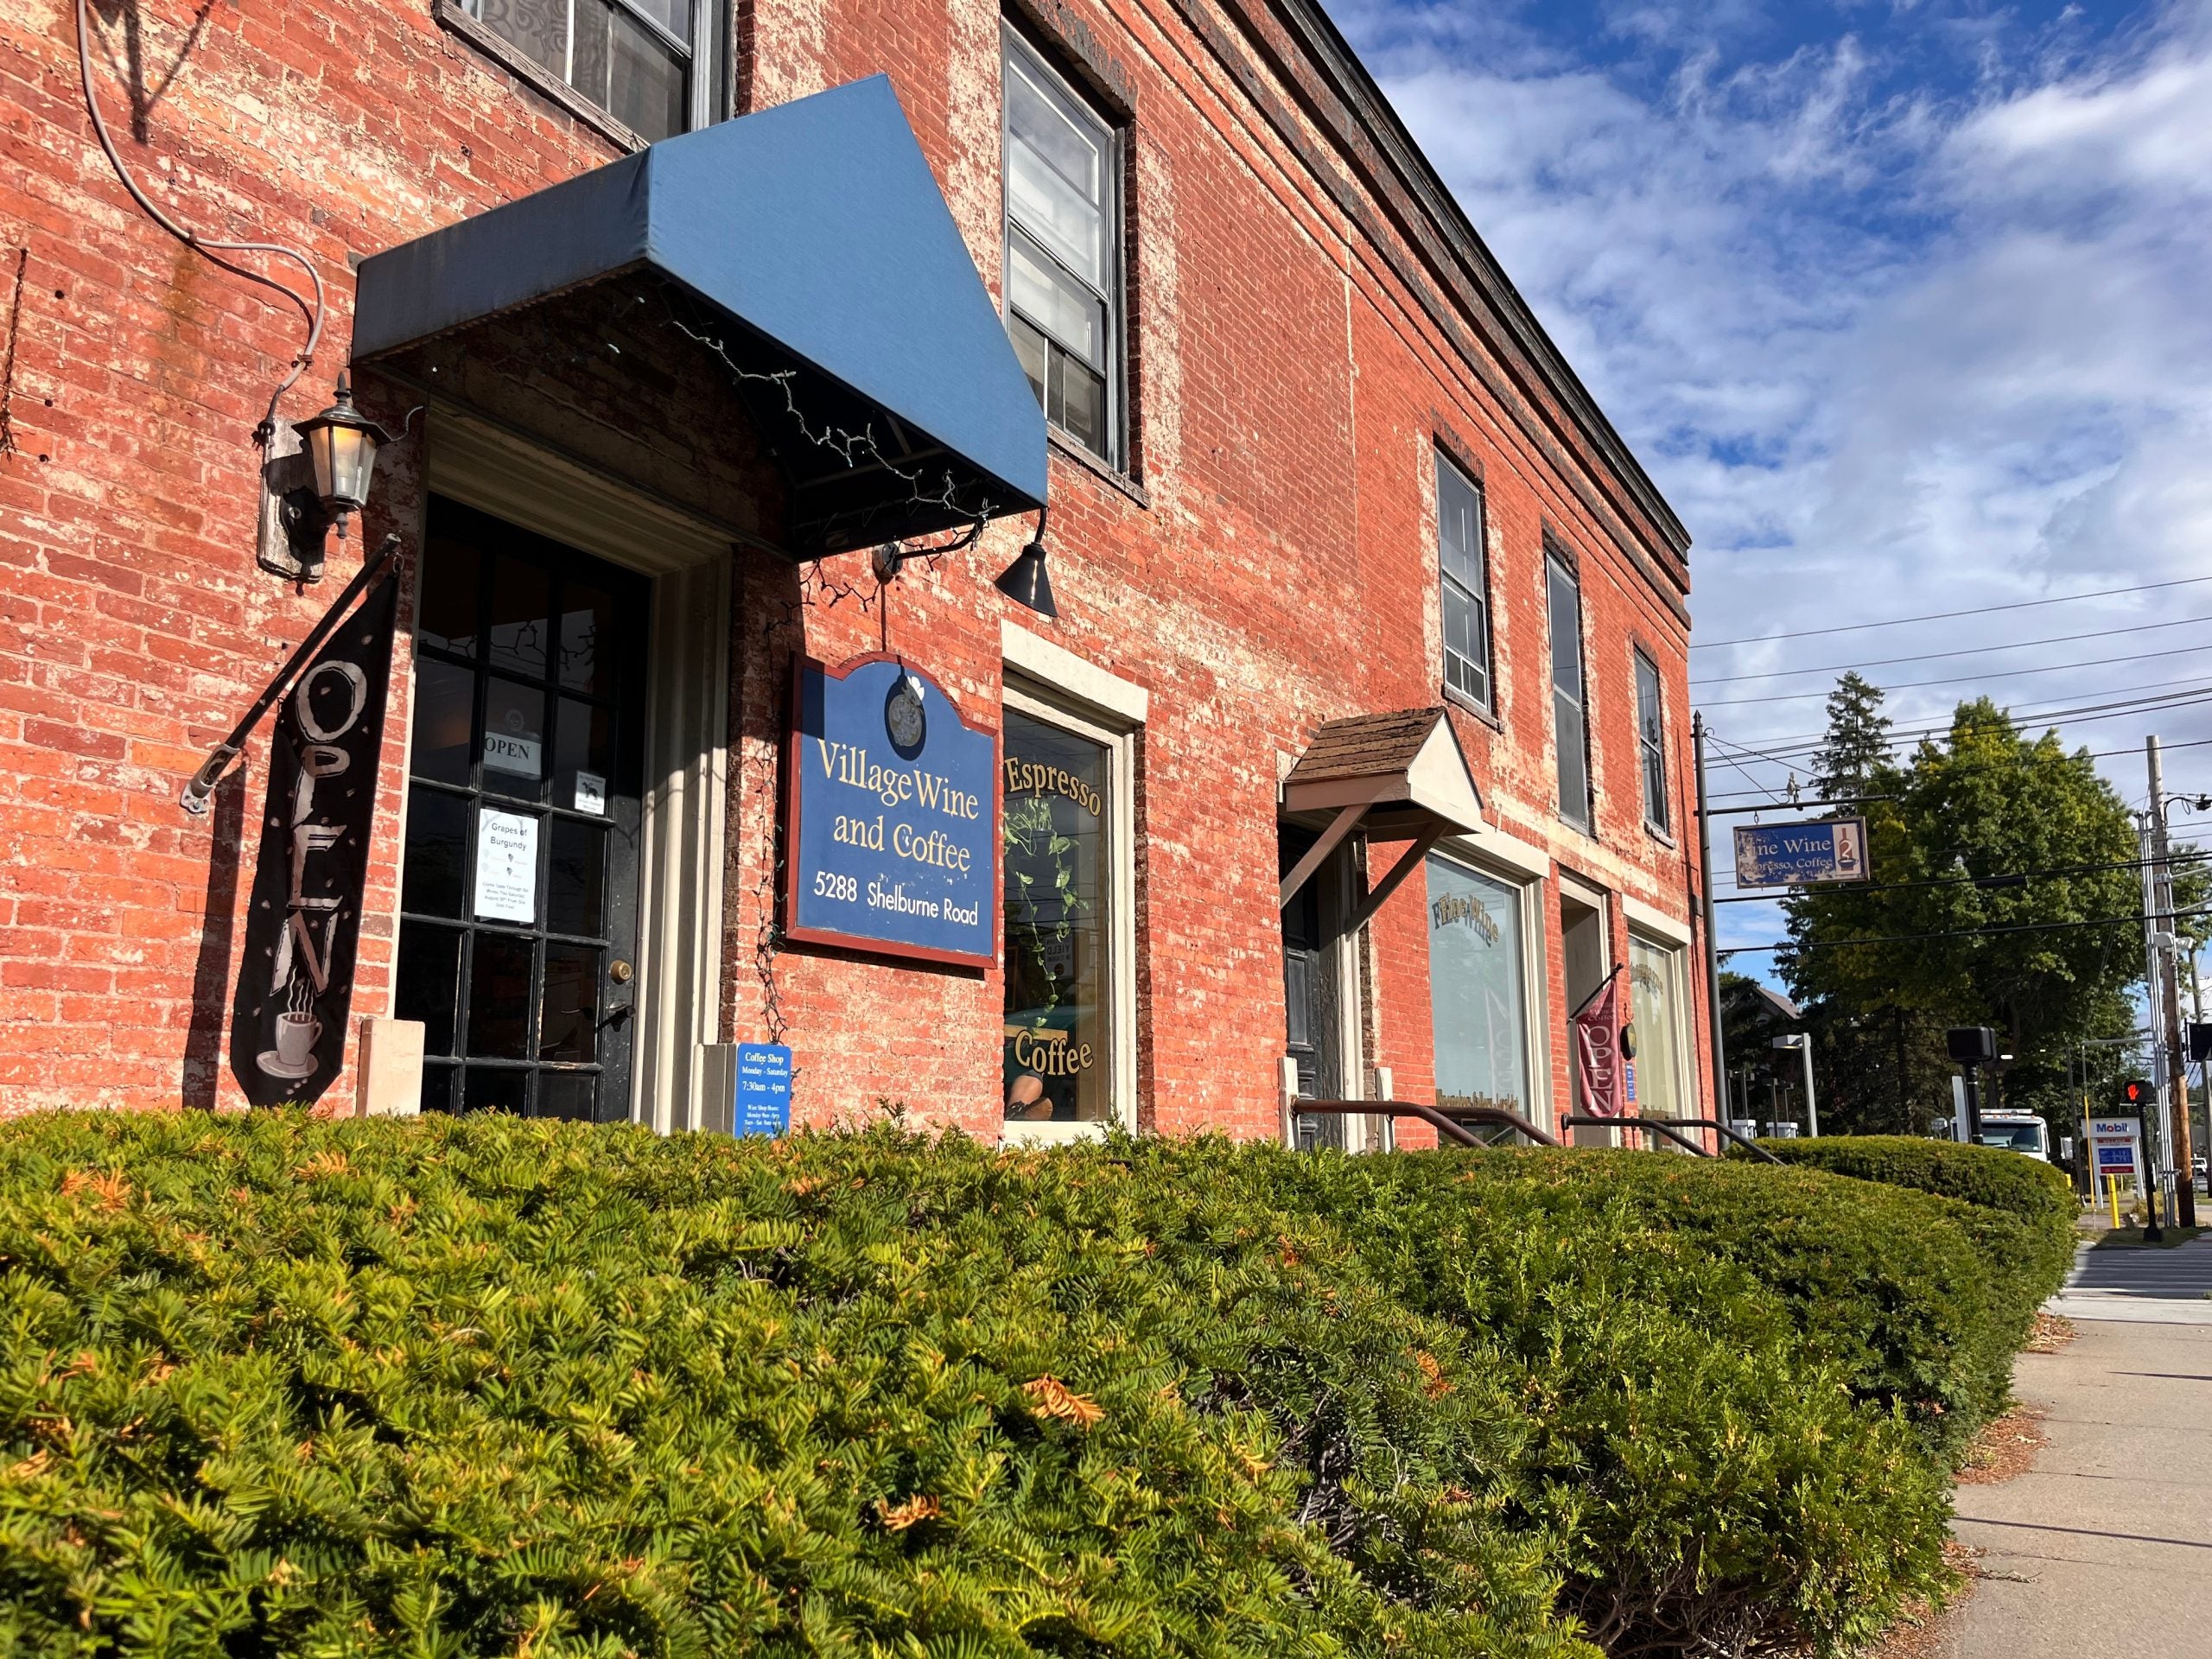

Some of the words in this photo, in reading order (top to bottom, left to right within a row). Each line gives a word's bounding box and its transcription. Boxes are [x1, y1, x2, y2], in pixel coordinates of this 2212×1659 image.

[484, 736, 531, 760] OPEN
[817, 738, 912, 807] Village
[913, 769, 979, 820] Wine
[1004, 756, 1102, 817] Espresso
[269, 659, 368, 998] OPEN
[492, 823, 518, 835] Grapes
[491, 836, 527, 851] Burgundy
[834, 815, 885, 852] and
[893, 823, 970, 872] Coffee
[1783, 837, 1832, 854] Wine
[1796, 856, 1833, 868] Coffee
[813, 871, 858, 902] 5288
[867, 881, 939, 918] Shelburne
[944, 898, 978, 926] Road
[1439, 893, 1466, 925] Fine
[1469, 894, 1499, 943] Wine
[745, 1052, 766, 1063] Coffee
[767, 1053, 784, 1065] Shop
[1014, 1029, 1094, 1076] Coffee
[741, 1066, 762, 1077] Monday
[767, 1067, 788, 1077] Saturday
[1587, 1025, 1614, 1112] OPEN
[742, 1081, 766, 1091] 7:30am
[772, 1083, 785, 1094] 4pm
[2096, 1123, 2127, 1133] Mobil
